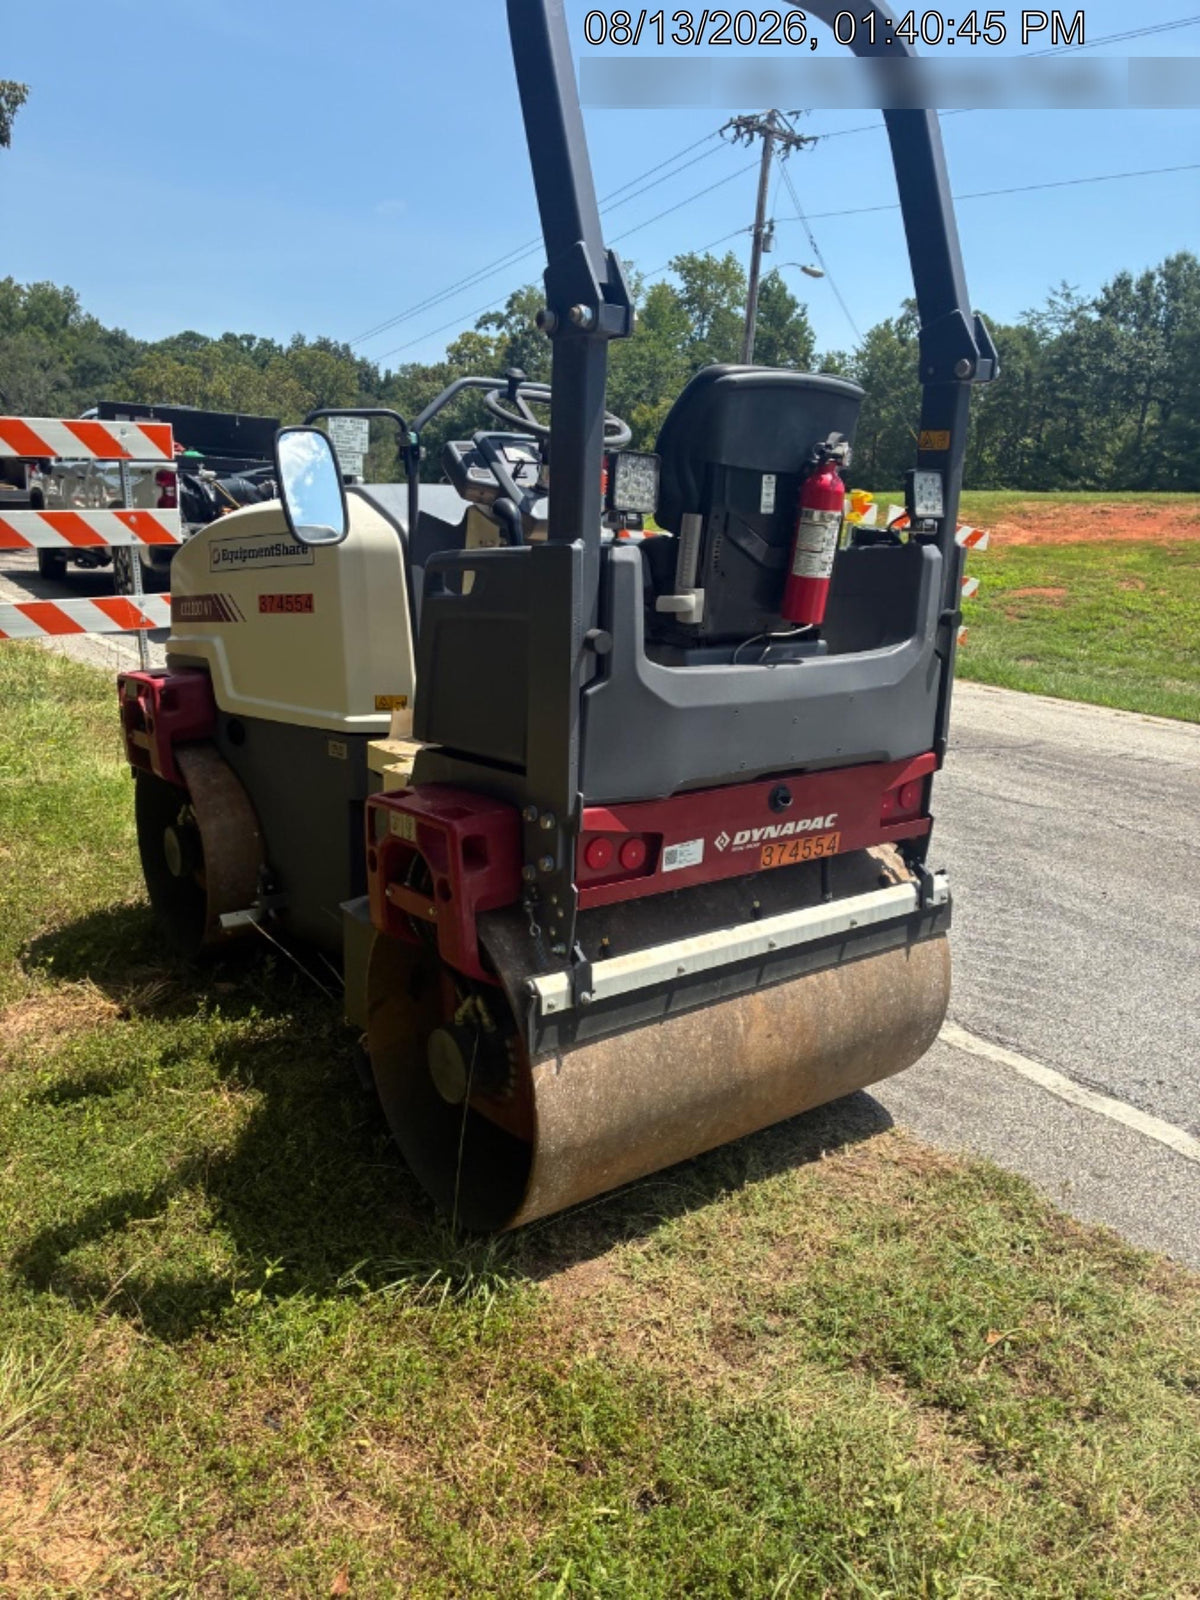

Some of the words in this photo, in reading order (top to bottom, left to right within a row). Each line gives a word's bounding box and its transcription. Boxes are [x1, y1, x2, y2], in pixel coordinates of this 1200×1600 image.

[222, 543, 308, 563] EquipmentShare
[260, 595, 313, 612] 374554
[733, 813, 838, 845] DYNAPAC
[762, 834, 837, 866] 374554
